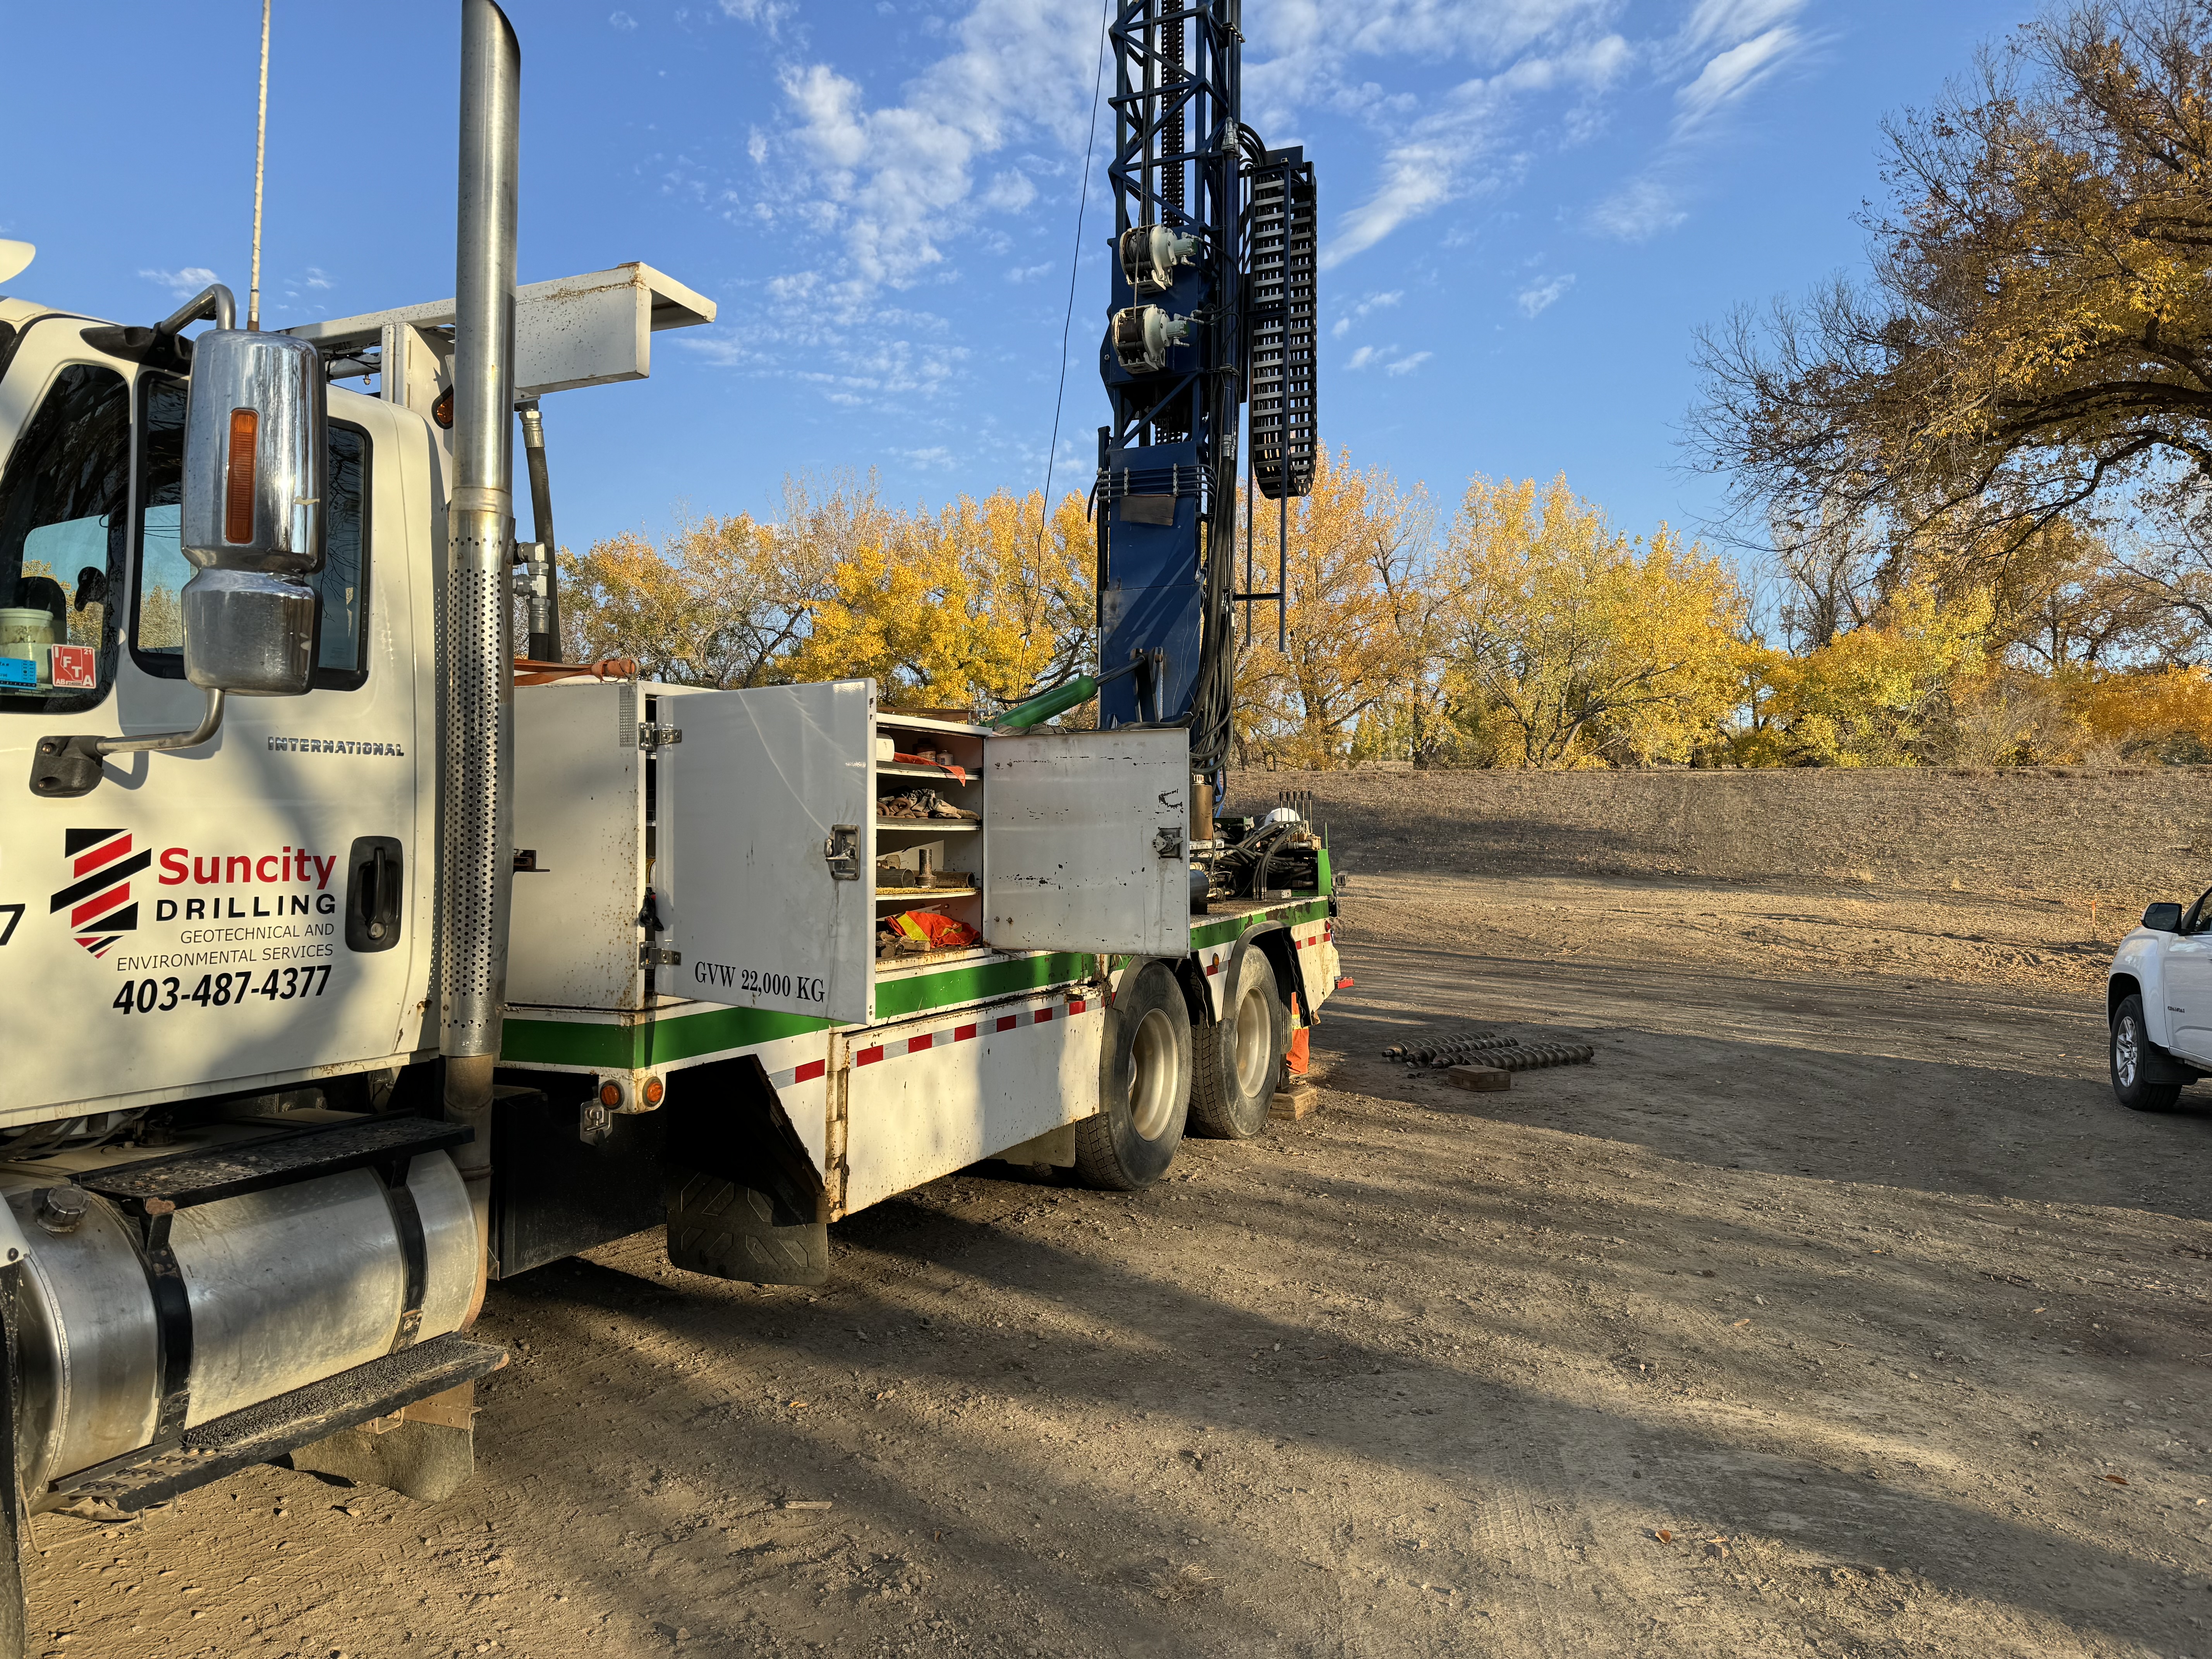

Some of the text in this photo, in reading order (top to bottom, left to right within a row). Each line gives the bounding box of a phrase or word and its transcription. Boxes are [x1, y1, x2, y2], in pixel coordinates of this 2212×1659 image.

[268, 737, 404, 756] INTERNATIONAL
[159, 847, 337, 890] Suncity
[0, 903, 26, 946] 7
[156, 894, 336, 922] DRILLING
[180, 924, 335, 944] GEOTECHNICAL AND
[117, 944, 333, 972] ENVIRONMENTAL SERVICES
[113, 965, 332, 1015] 403-487-4377
[695, 962, 825, 1003] GVW 22,000 KG
